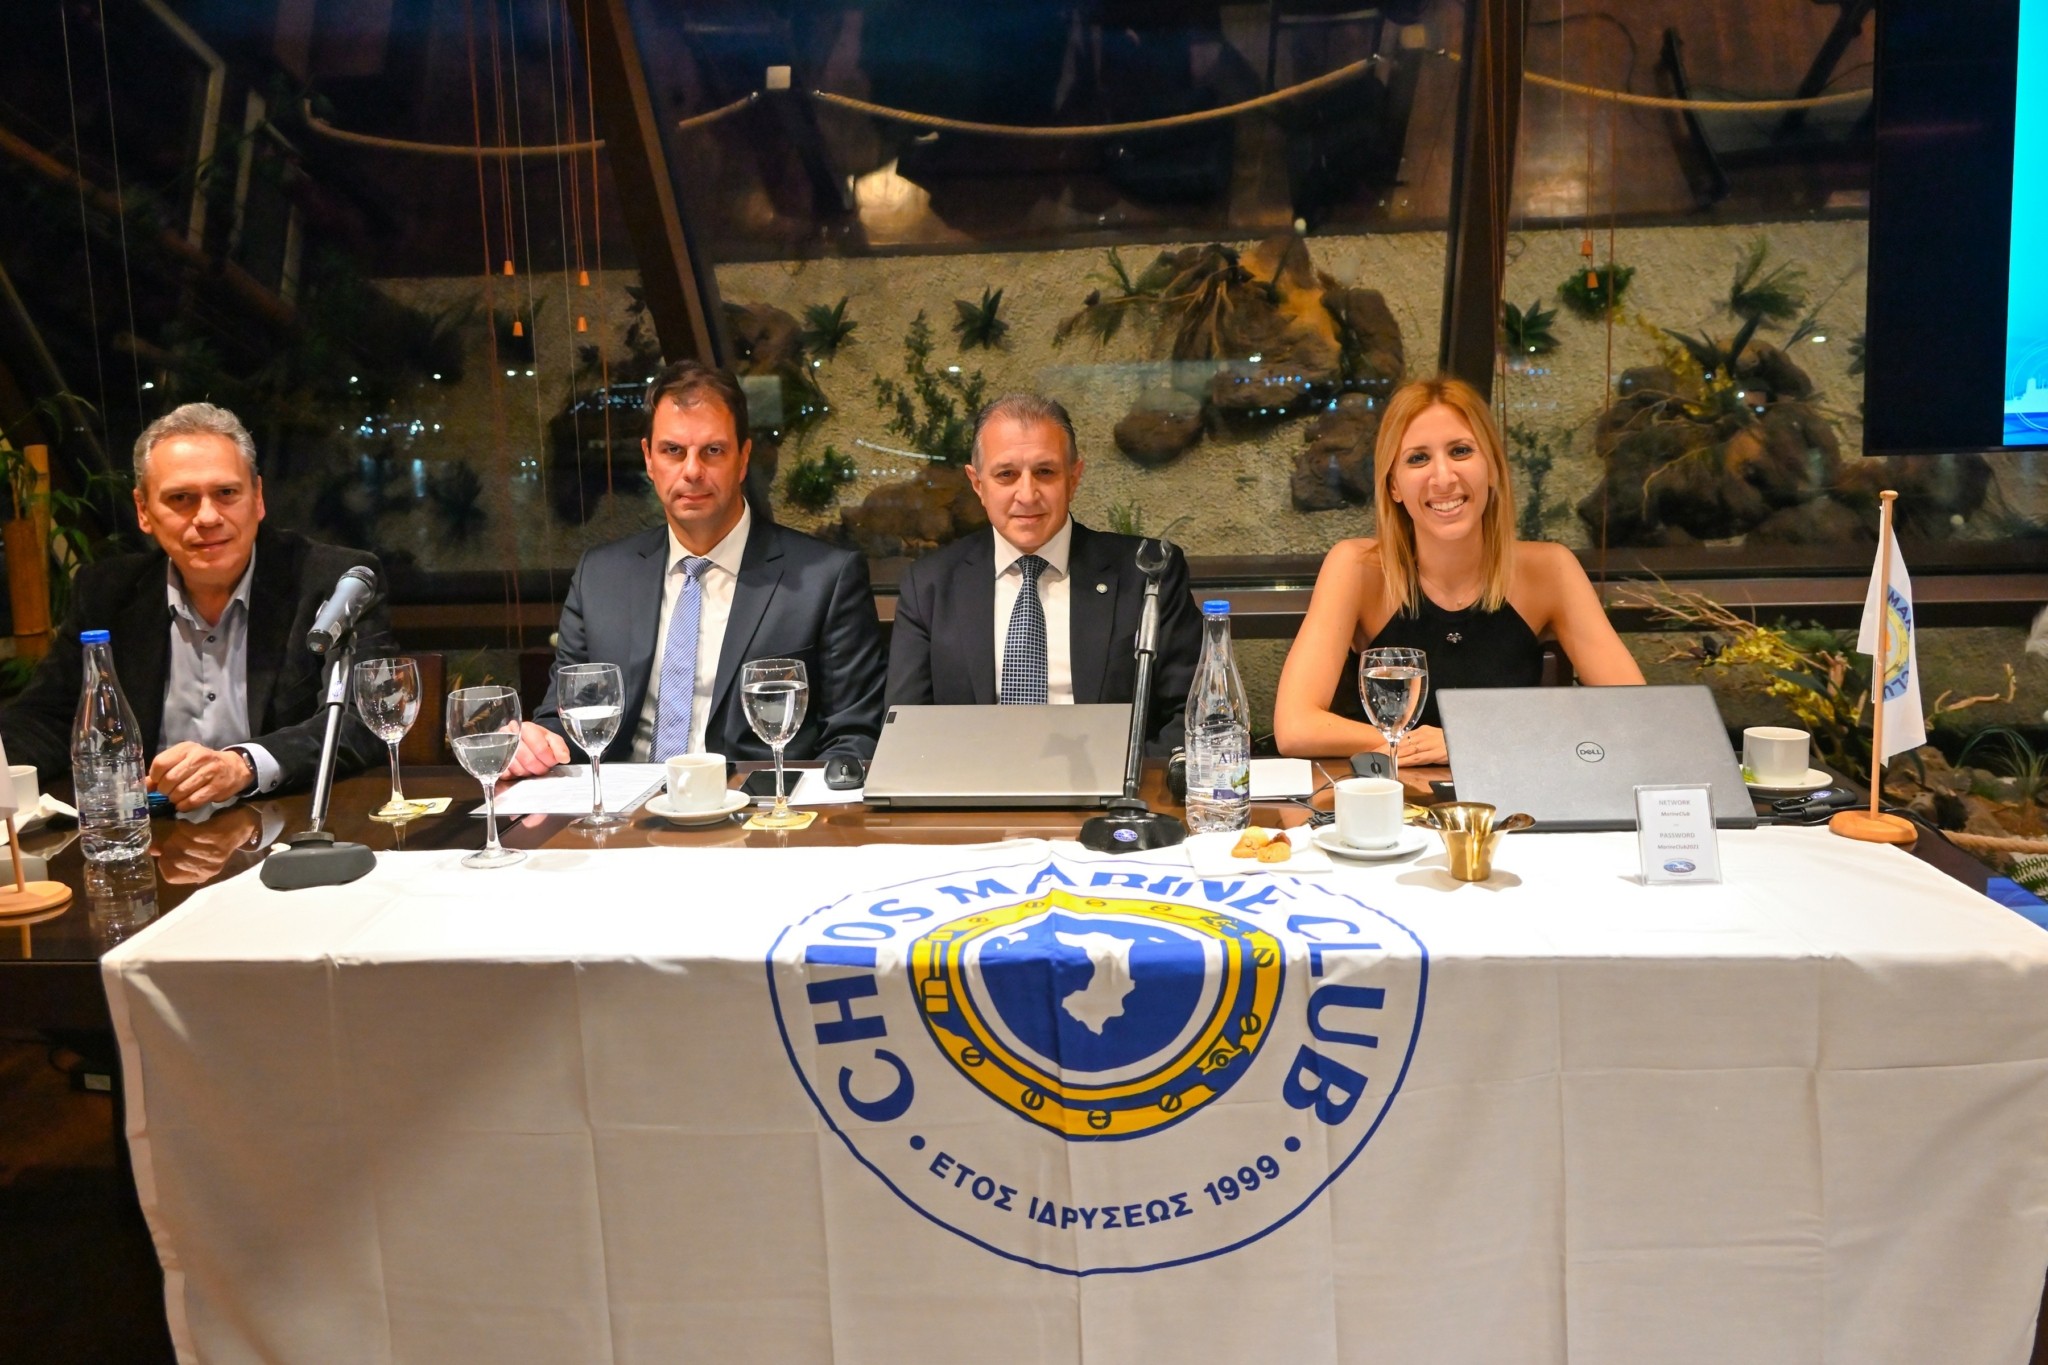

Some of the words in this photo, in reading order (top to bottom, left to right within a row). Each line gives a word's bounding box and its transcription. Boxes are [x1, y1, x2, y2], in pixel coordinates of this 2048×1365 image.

[804, 897, 935, 1122] CHIOS
[936, 862, 1281, 915] MARINE
[1277, 913, 1386, 1126] CLUB
[929, 1152, 1018, 1211] ΕΤΟΣ
[1028, 1191, 1193, 1231] ΙΔΡΥΣΕΩΣ
[1203, 1154, 1281, 1207] 1999
